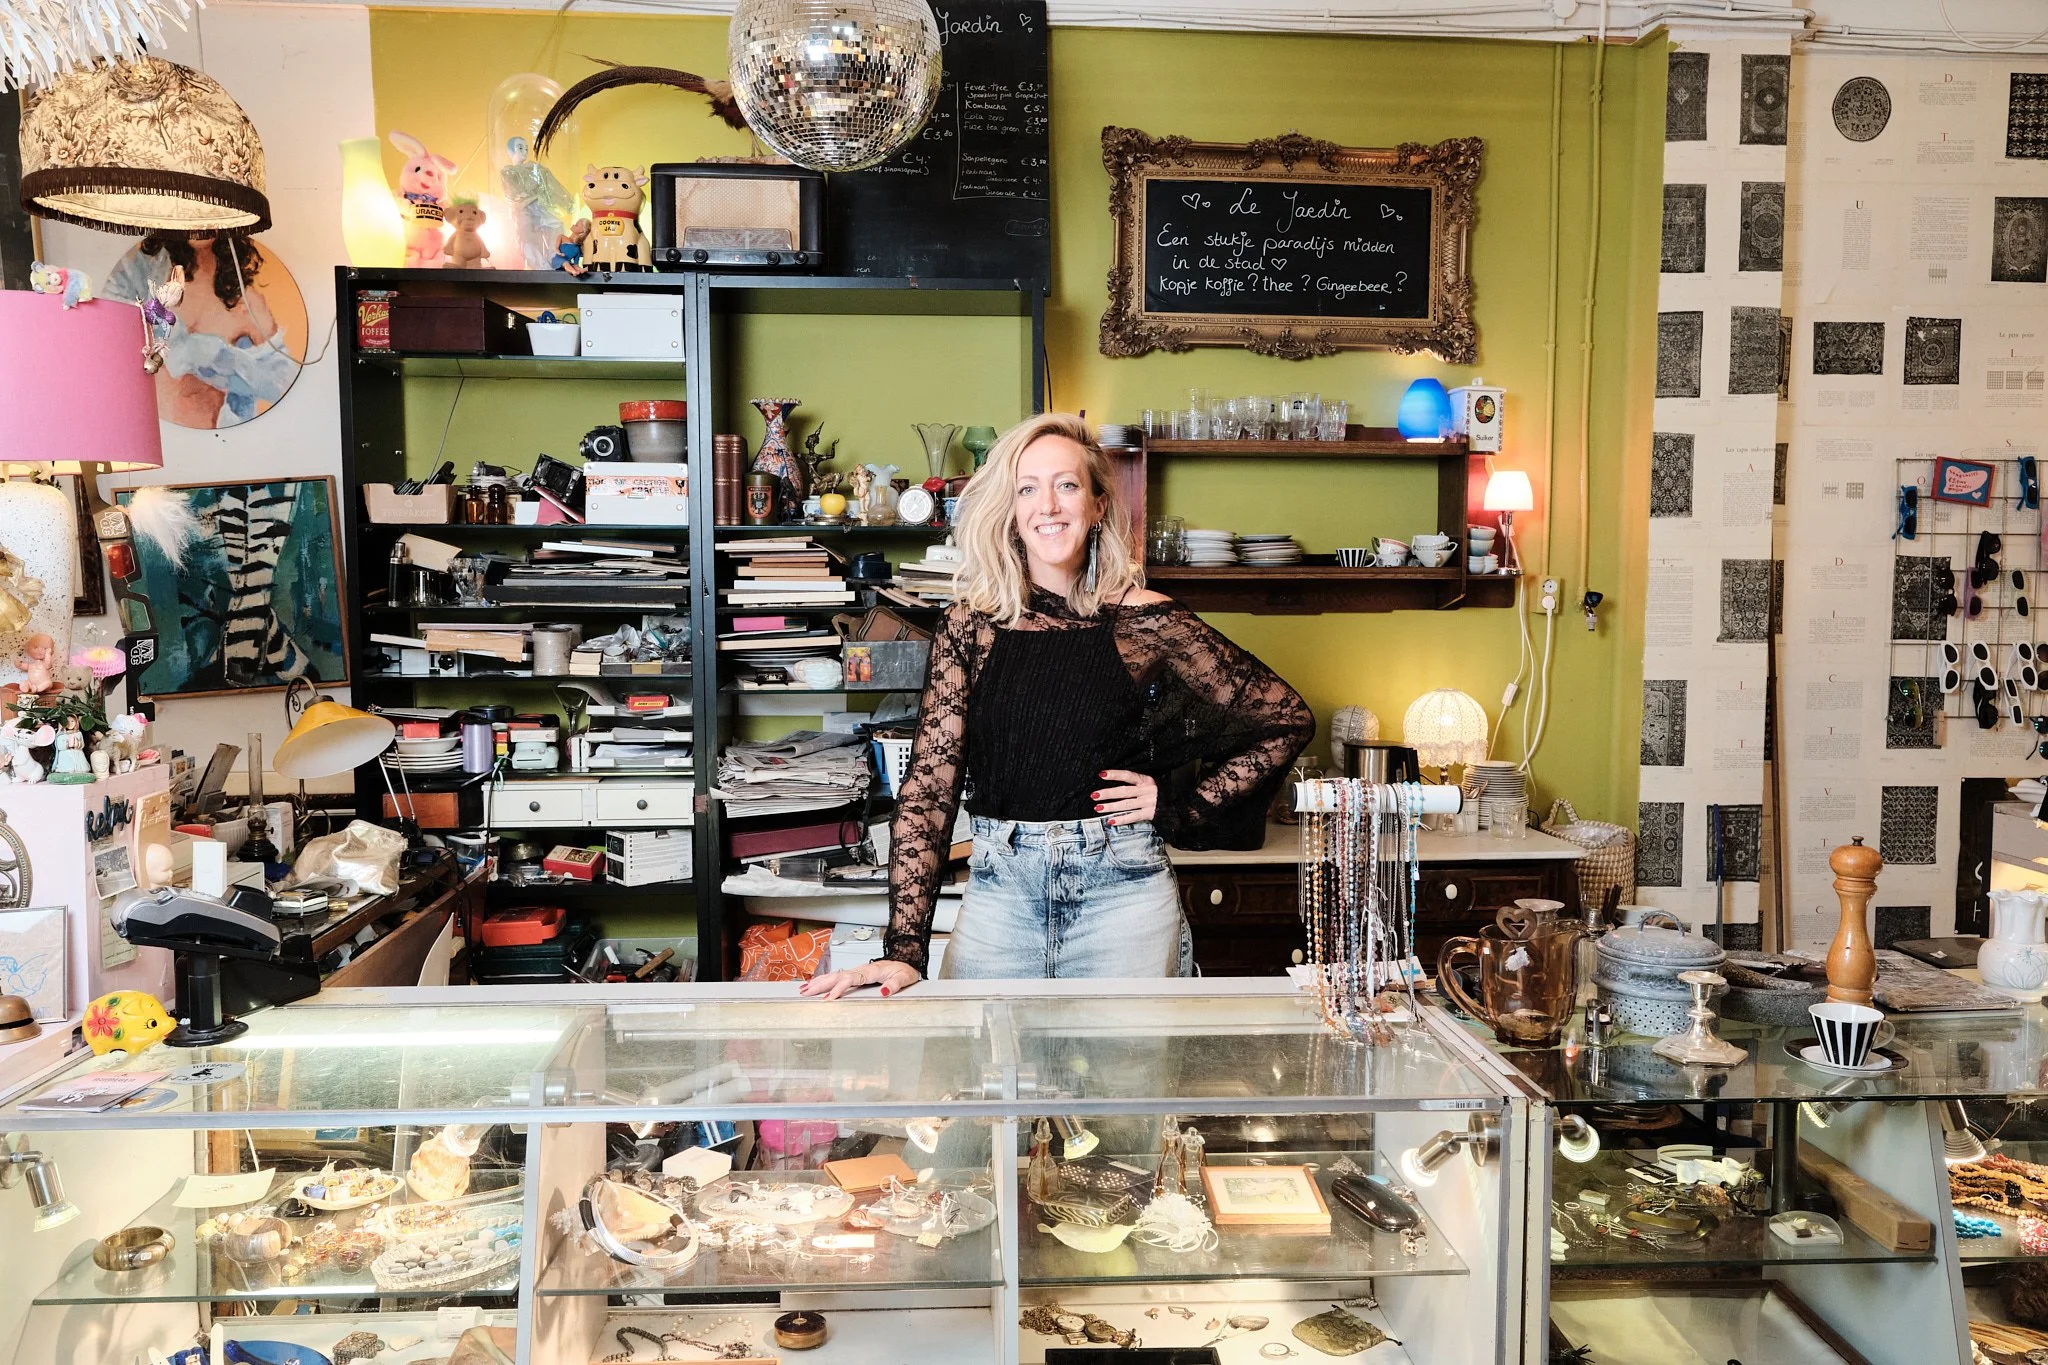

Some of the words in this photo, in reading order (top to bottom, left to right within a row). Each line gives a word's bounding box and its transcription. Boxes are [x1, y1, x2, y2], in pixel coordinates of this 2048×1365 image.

[936, 7, 1003, 46] Jardin
[1944, 73, 1953, 83] D
[965, 100, 1008, 111] Kombucha
[963, 111, 984, 120] Cola
[986, 123, 998, 131] tea
[1002, 126, 1020, 135] green
[1940, 132, 1949, 142] T
[1856, 200, 1864, 210] U
[1229, 188, 1261, 215] Le
[1276, 190, 1351, 234] Jardin
[1156, 223, 1189, 247] Een
[1203, 231, 1255, 257] stukje
[1263, 236, 1335, 258] paradijs
[1343, 237, 1396, 254] midden
[1172, 255, 1190, 270] in
[1199, 255, 1220, 269] de
[1224, 256, 1266, 271] stad
[2005, 439, 2012, 448] S
[1746, 463, 1754, 473] A
[1835, 556, 1844, 567] D
[1828, 673, 1838, 683] C
[1827, 726, 1835, 735] T
[1823, 787, 1832, 796] V
[1815, 905, 1824, 915] C
